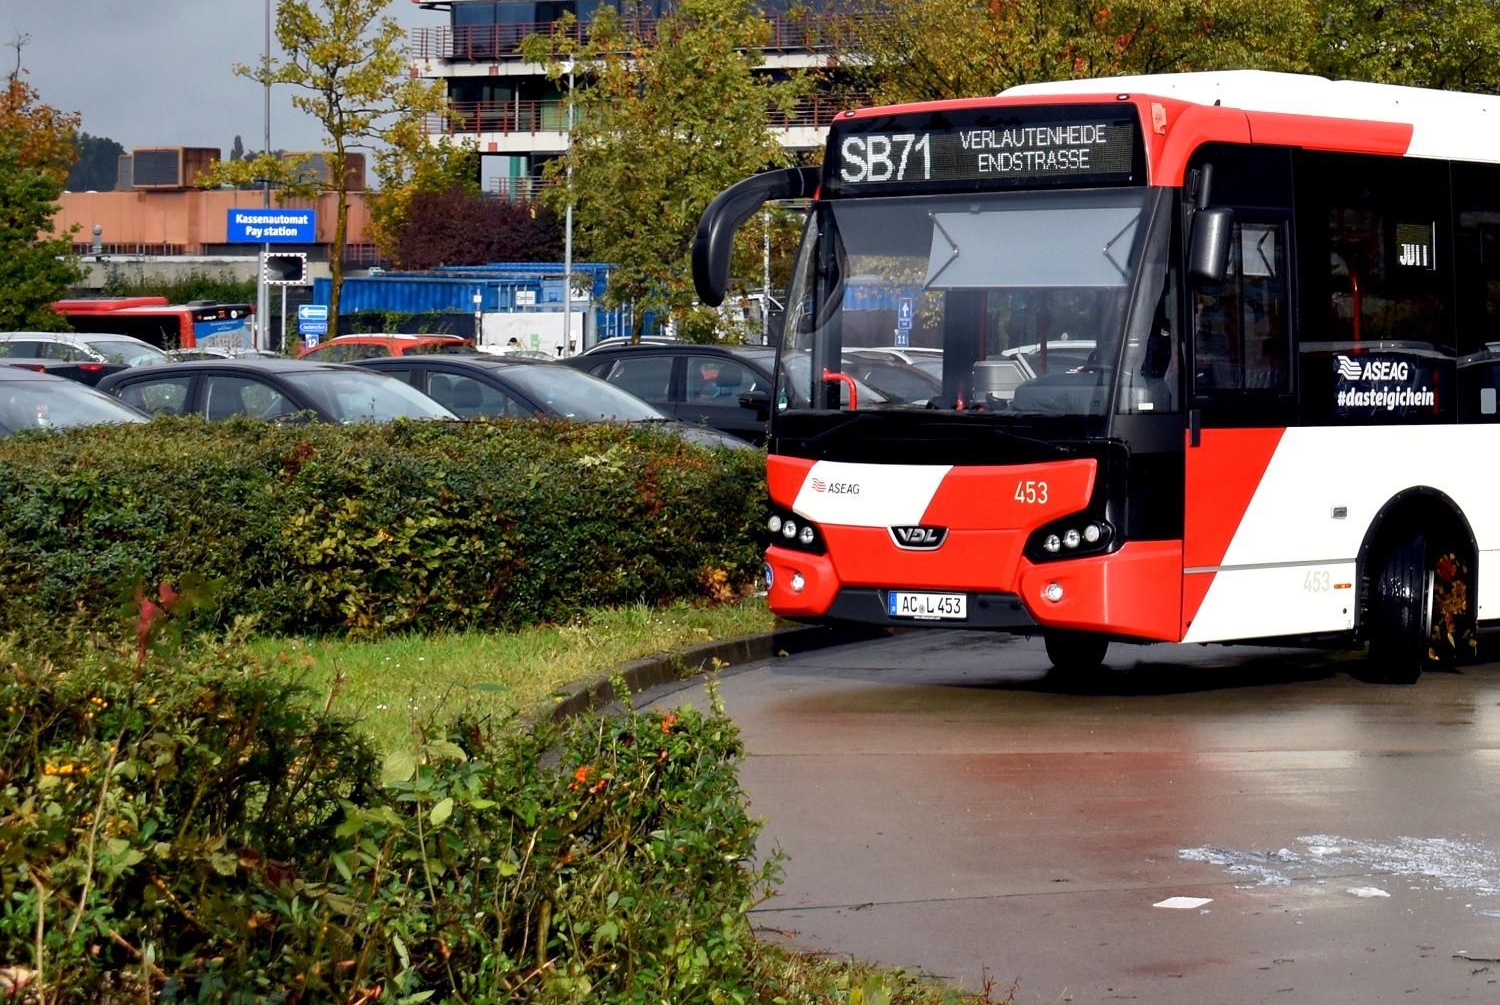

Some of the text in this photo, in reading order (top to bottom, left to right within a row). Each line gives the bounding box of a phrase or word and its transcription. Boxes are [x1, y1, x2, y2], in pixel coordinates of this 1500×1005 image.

[960, 124, 1107, 150] VERLAUTENHEIDE
[840, 133, 931, 183] SB71
[978, 149, 1090, 173] ENDSTRASSE
[235, 213, 309, 225] Kassenautomat
[245, 226, 298, 238] Pay station
[308, 338, 317, 348] 12
[897, 335, 906, 344] 11
[1361, 361, 1409, 381] ASEAG
[1337, 385, 1434, 411] #dasteigichein
[827, 482, 860, 495] ASEAG
[1014, 480, 1048, 504] 453
[897, 527, 938, 543] VDL
[1303, 570, 1330, 593] 453
[902, 596, 961, 614] AC L 453
